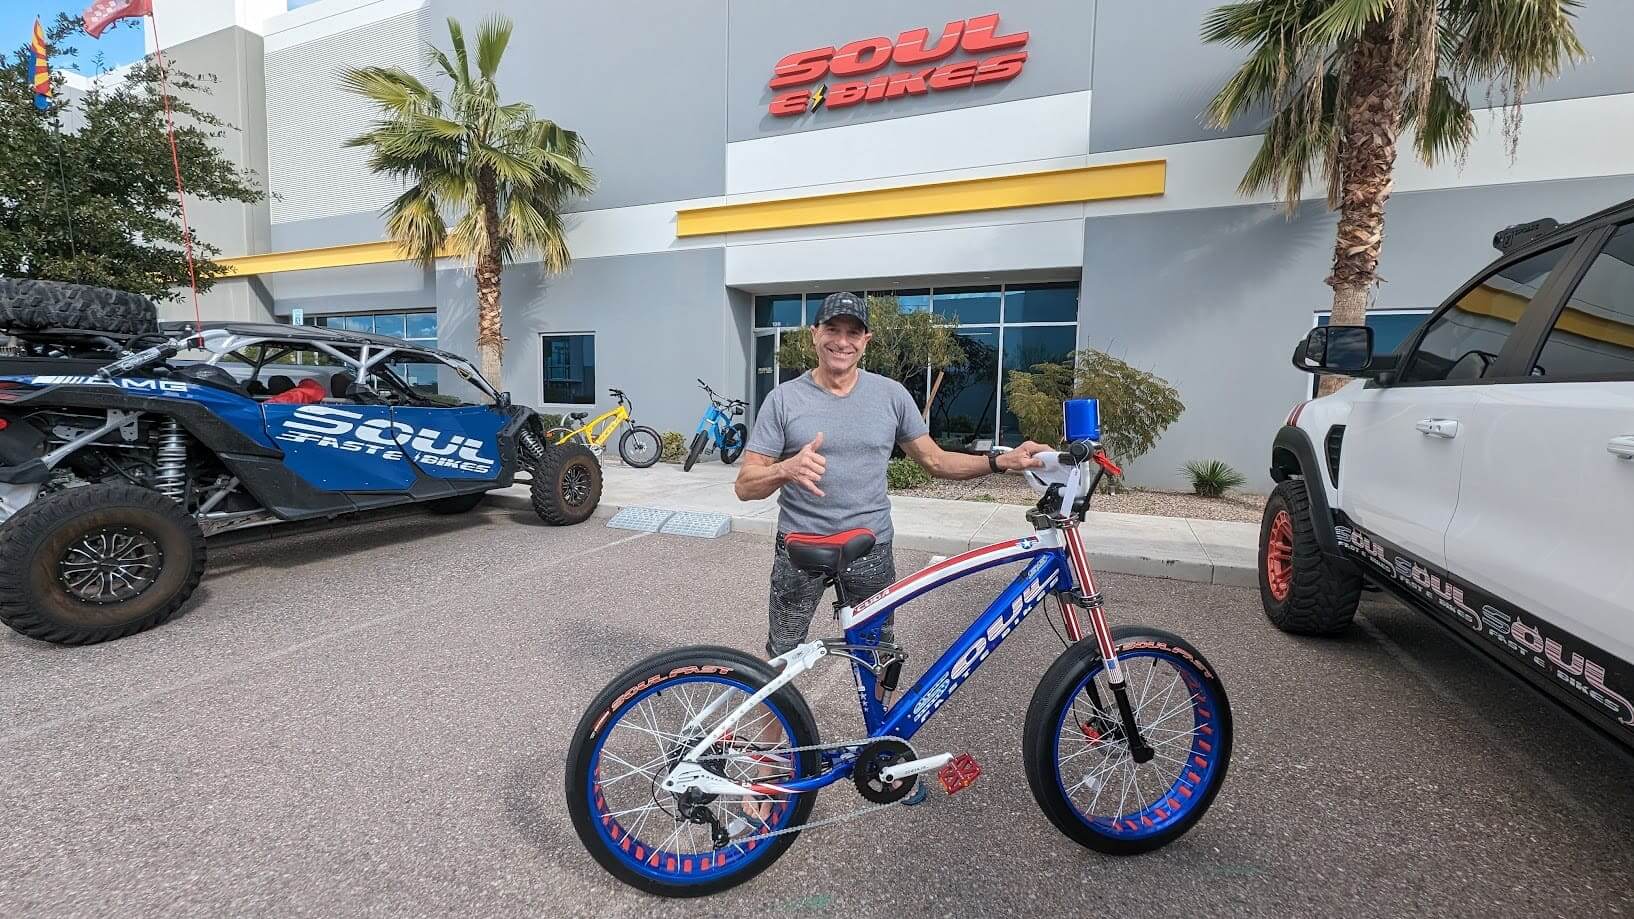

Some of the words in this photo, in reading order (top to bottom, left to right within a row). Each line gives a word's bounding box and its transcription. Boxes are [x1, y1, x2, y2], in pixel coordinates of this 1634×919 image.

[768, 12, 1030, 90] SOUL
[826, 50, 1029, 110] BIKES
[275, 430, 386, 455] FAST
[418, 454, 492, 474] BIKES
[282, 405, 495, 465] SOUL
[1394, 556, 1483, 632] SOUL
[913, 567, 1060, 722] SOUL
[1481, 604, 1634, 726] SOUL
[1488, 628, 1531, 656] FAST
[1556, 670, 1620, 713] BIKES
[611, 673, 668, 712] SOUL
